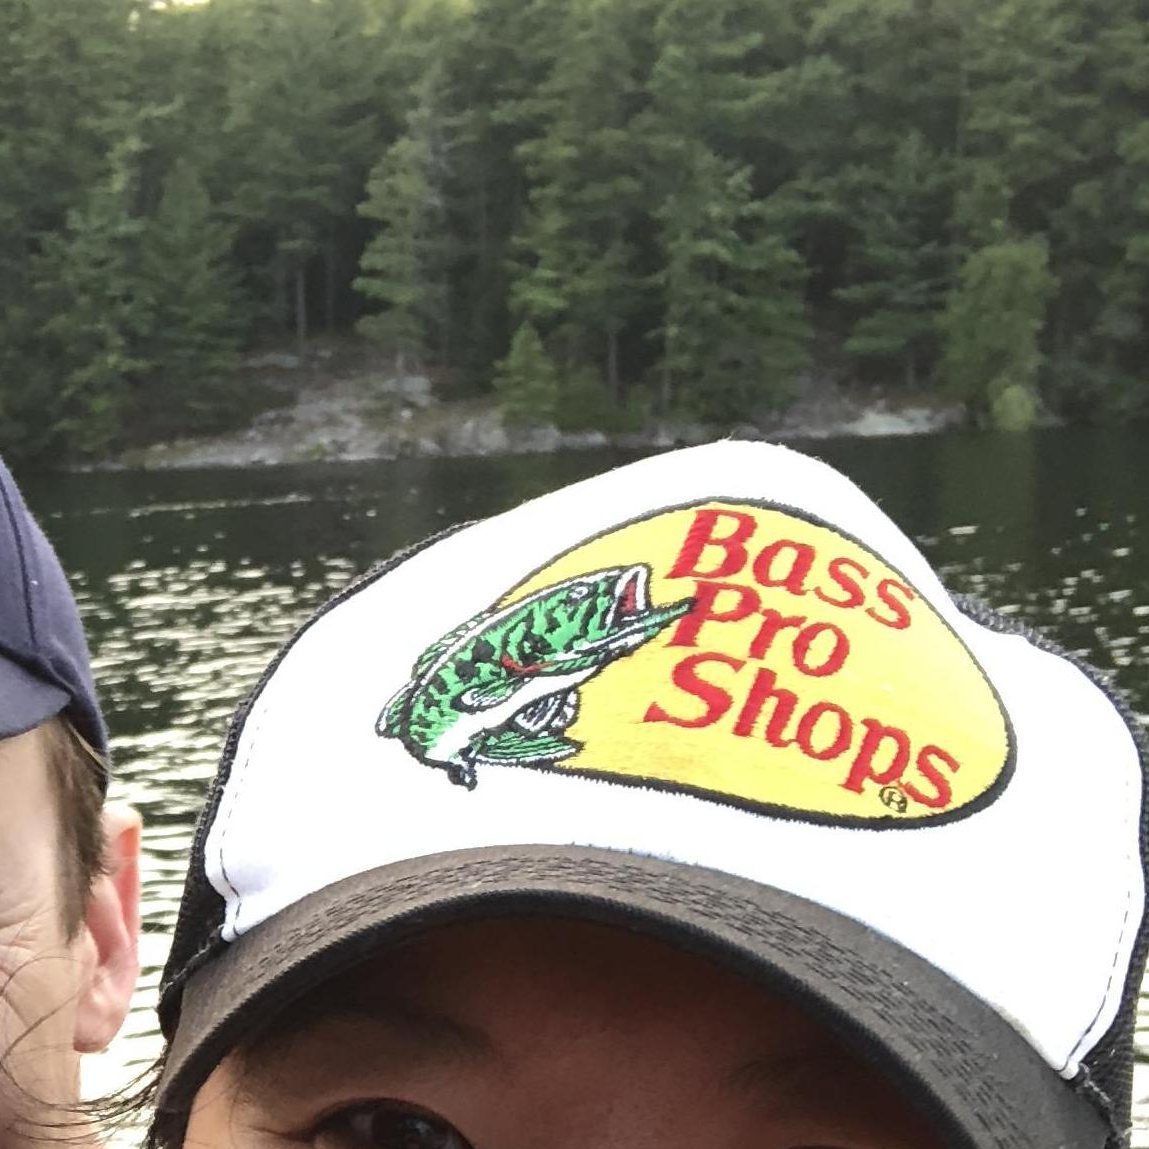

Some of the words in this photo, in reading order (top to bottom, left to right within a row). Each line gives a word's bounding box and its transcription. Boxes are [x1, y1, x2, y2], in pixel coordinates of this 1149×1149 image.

[665, 509, 915, 630] Bass
[666, 580, 850, 677] Pro
[644, 652, 960, 808] Shops
